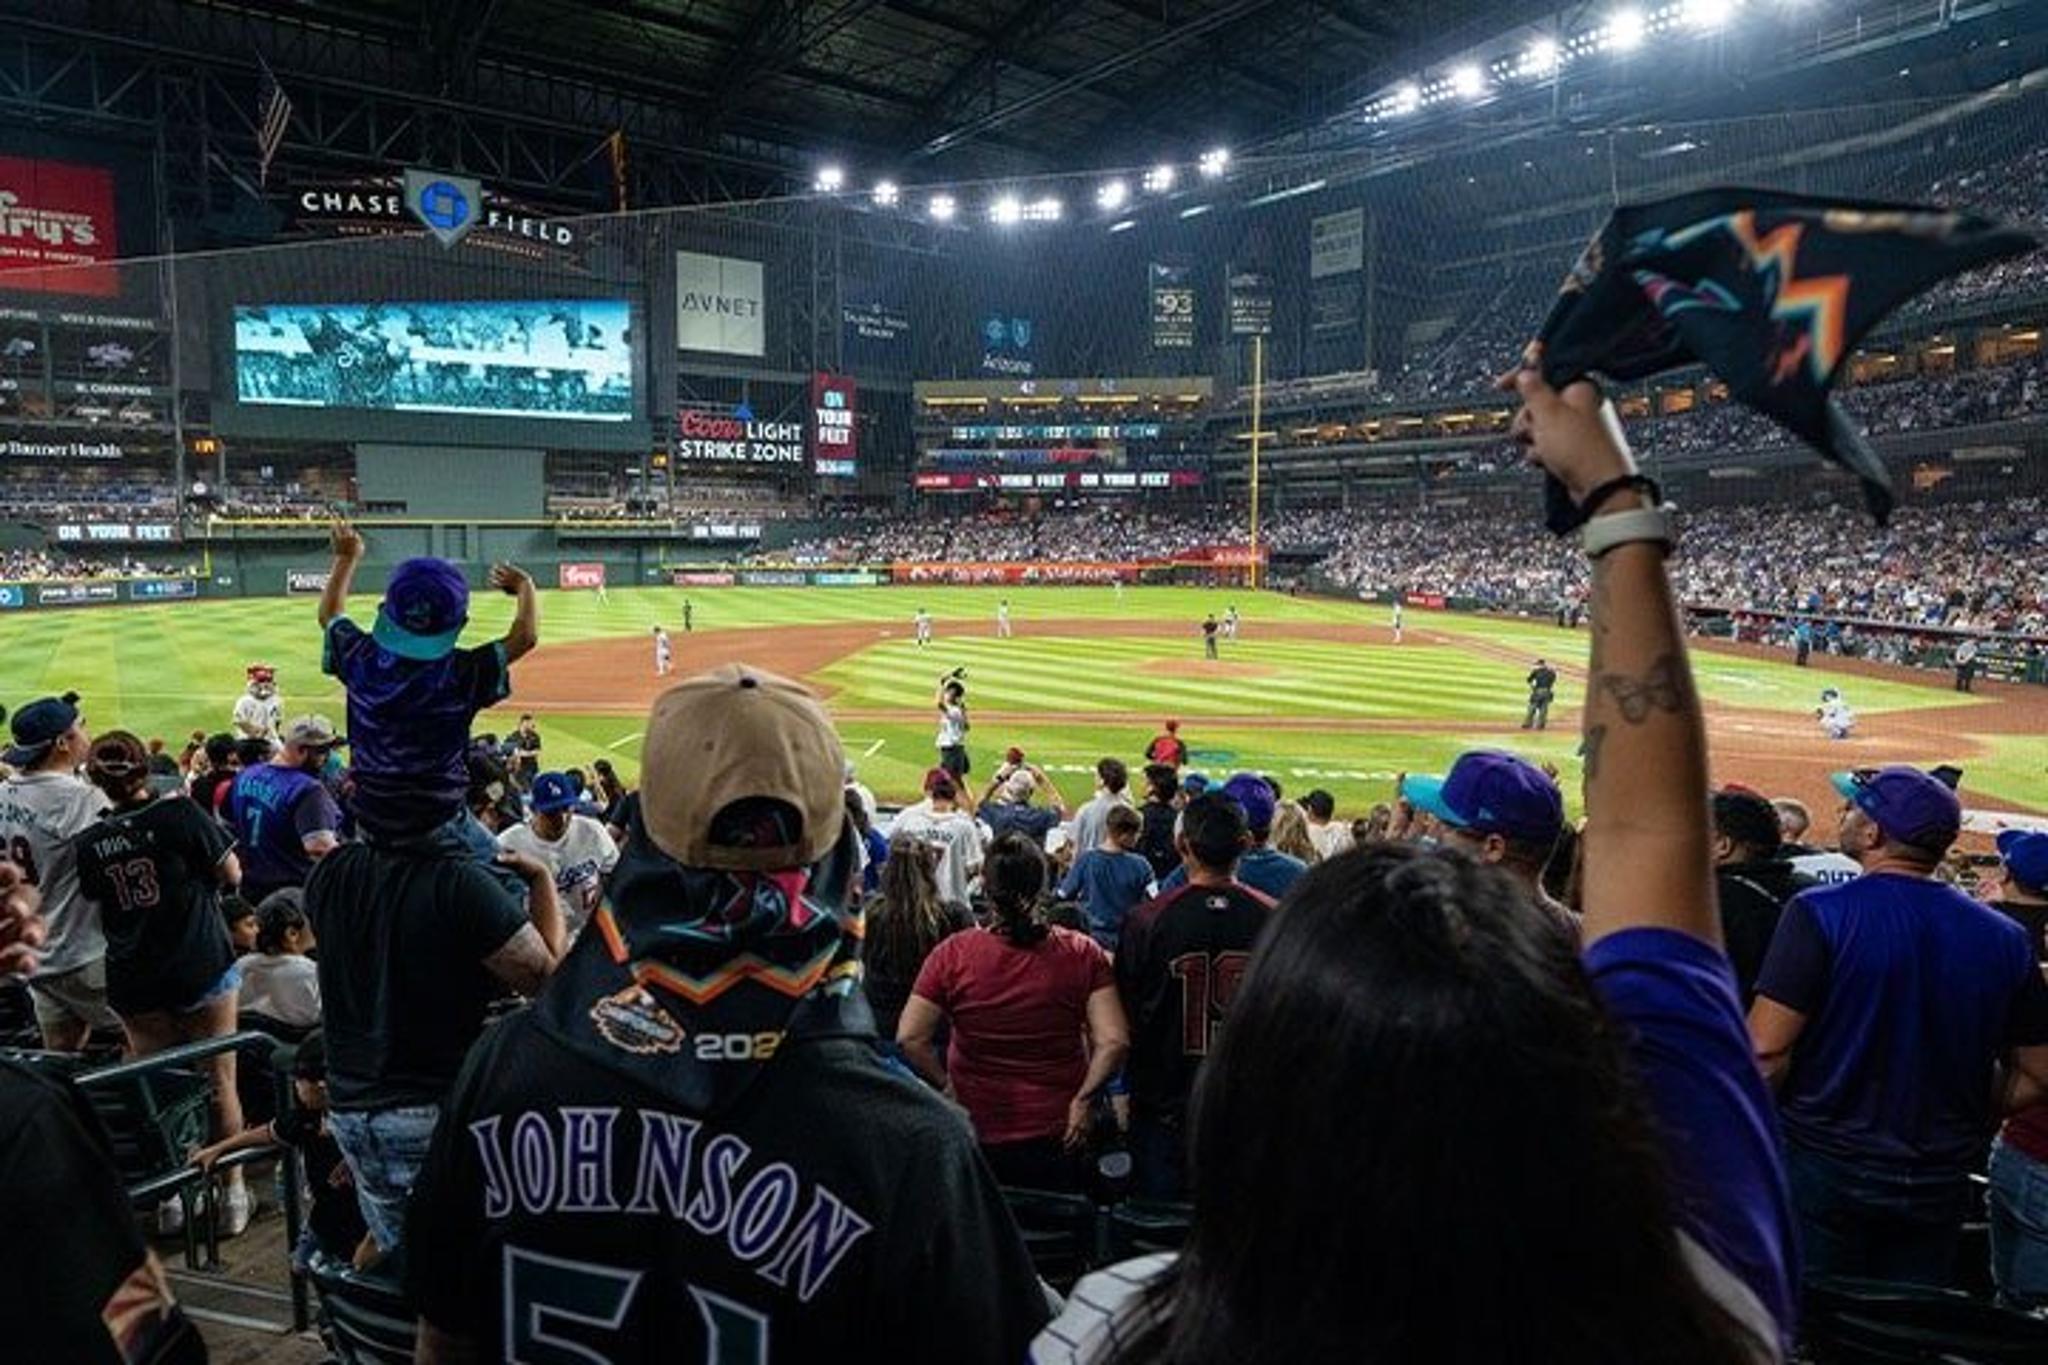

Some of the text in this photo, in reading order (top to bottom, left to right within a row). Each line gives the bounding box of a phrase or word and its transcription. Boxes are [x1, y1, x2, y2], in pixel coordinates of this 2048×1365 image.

[302, 192, 573, 245] CHASE FIELD
[682, 292, 760, 317] AVNET
[824, 390, 844, 408] ON
[816, 409, 852, 425] YOUR
[746, 422, 802, 441] LIGHT
[819, 426, 850, 445] FEET
[9, 442, 124, 459] Banner Health
[680, 440, 803, 461] STRIKE ZONE
[59, 525, 172, 539] ON YOUR FEET
[247, 805, 262, 847] 7
[104, 857, 161, 911] 13
[694, 1030, 788, 1060] 202
[469, 1107, 873, 1300] JOHNSON
